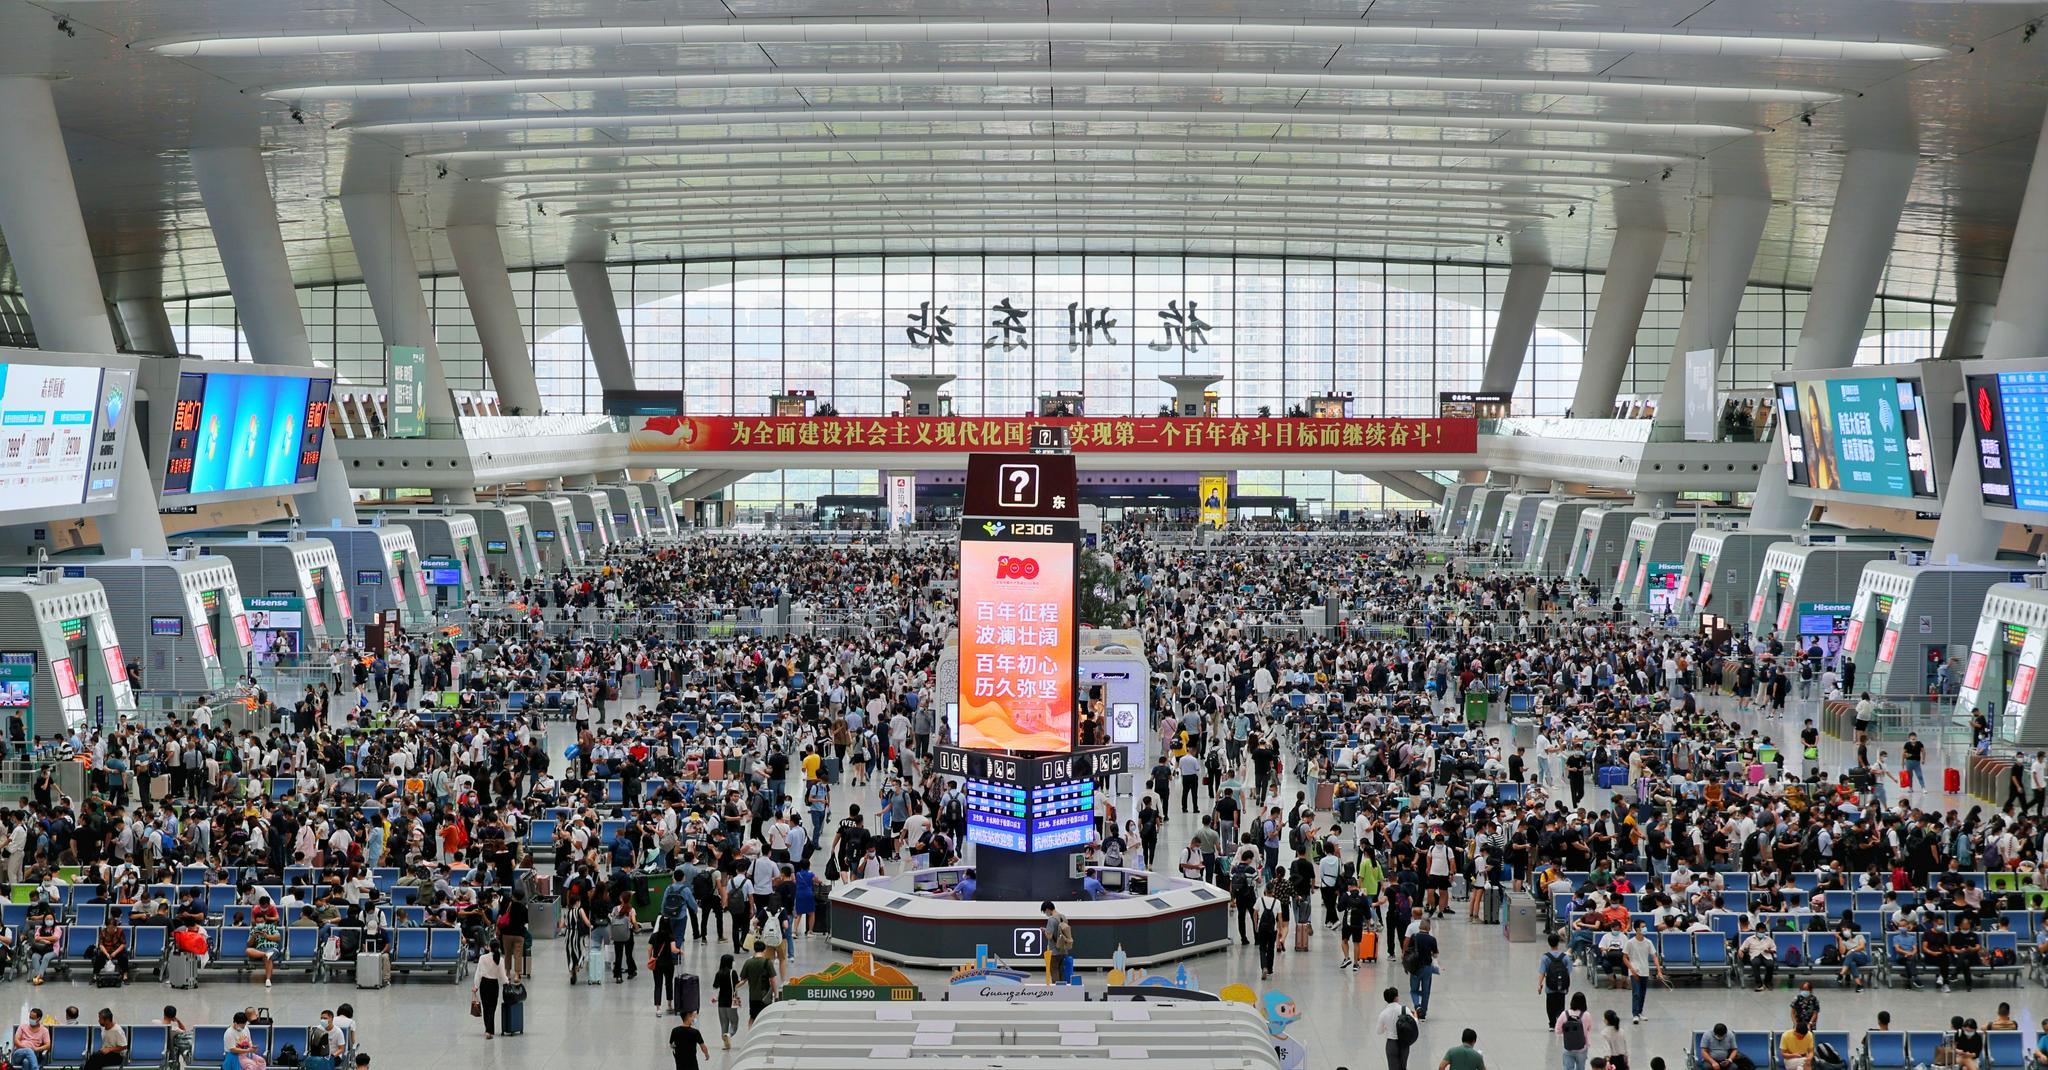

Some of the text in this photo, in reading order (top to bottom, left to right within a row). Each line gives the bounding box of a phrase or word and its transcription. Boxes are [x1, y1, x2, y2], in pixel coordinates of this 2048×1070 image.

[175, 400, 202, 431] 喜临门
[307, 401, 328, 428] 喜临门
[1052, 495, 1066, 509] 东
[1011, 523, 1054, 536] 12306
[975, 601, 1059, 623] 百年征程
[1813, 603, 1851, 611] Hisense
[975, 624, 1059, 647] 波澜壮阔
[975, 653, 1059, 675] 百年初心
[974, 676, 1058, 699] 历久弥坚
[807, 989, 875, 999] BEIJING 1990
